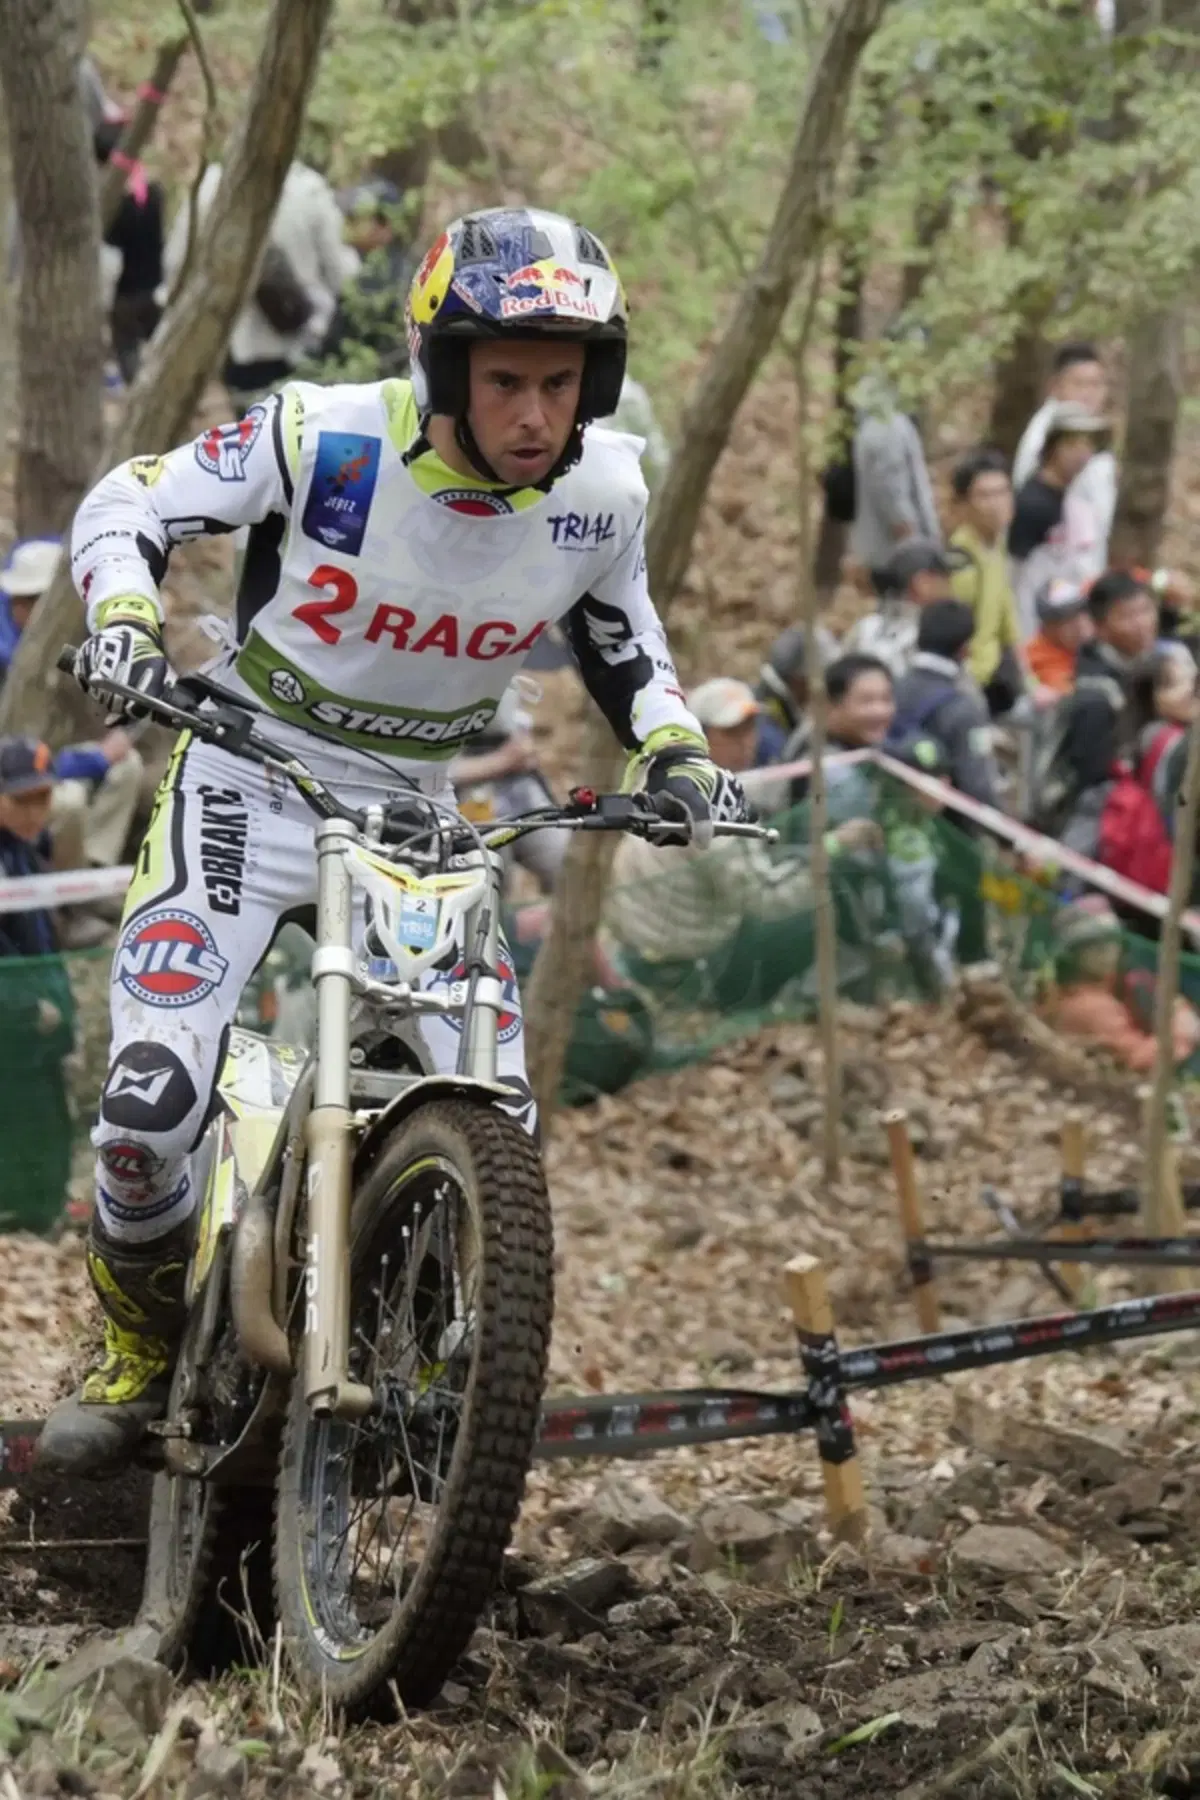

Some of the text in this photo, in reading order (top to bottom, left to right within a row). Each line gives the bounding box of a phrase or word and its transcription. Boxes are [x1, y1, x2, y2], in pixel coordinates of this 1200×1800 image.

[503, 288, 552, 315] Red
[555, 290, 600, 317] Bull
[547, 511, 616, 544] TRIAL
[291, 564, 358, 646] 2
[308, 700, 497, 743] STRIDER
[416, 900, 427, 912] 2
[112, 939, 229, 987] NILS
